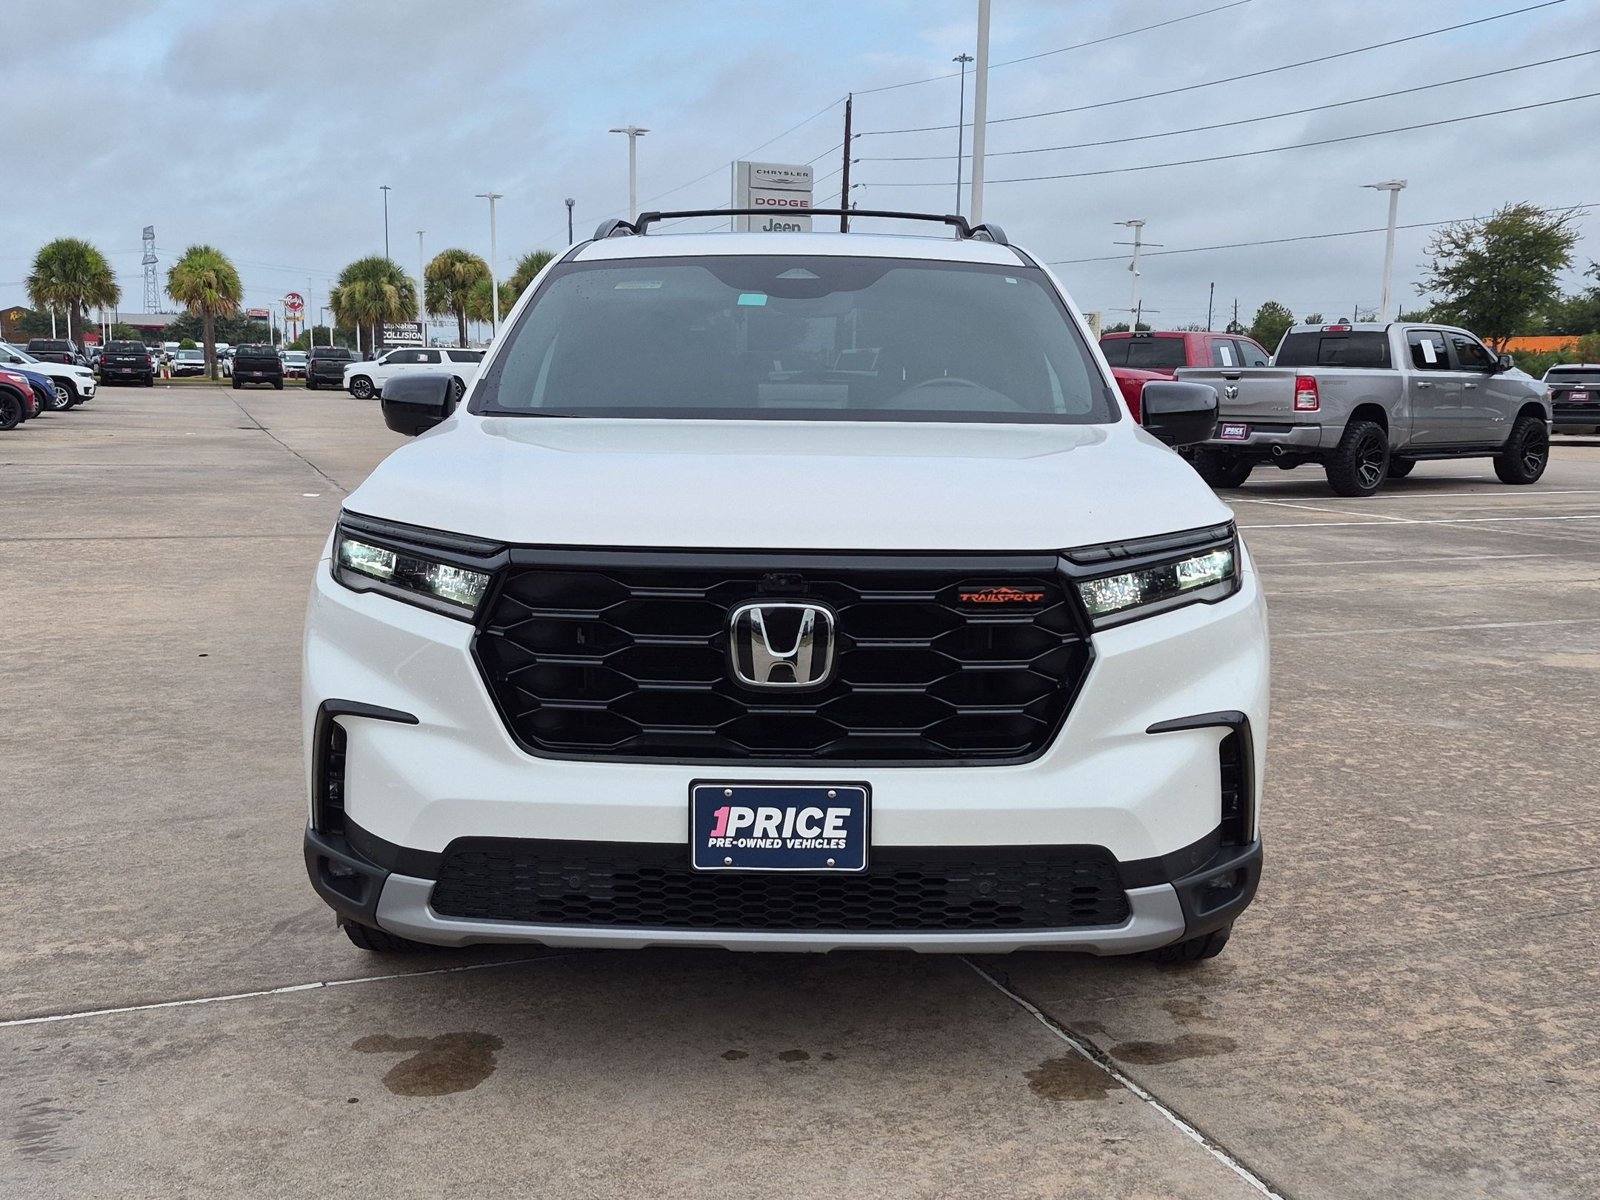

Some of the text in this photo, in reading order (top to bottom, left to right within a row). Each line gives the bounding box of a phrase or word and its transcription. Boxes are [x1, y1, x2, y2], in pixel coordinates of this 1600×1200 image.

[756, 169, 809, 177] CHRYSLER
[755, 197, 809, 208] DODGE
[960, 593, 1044, 603] TRAILSPORT
[710, 806, 851, 838] 1PRICE
[708, 837, 846, 849] PRE-OWNED VEHICLES
